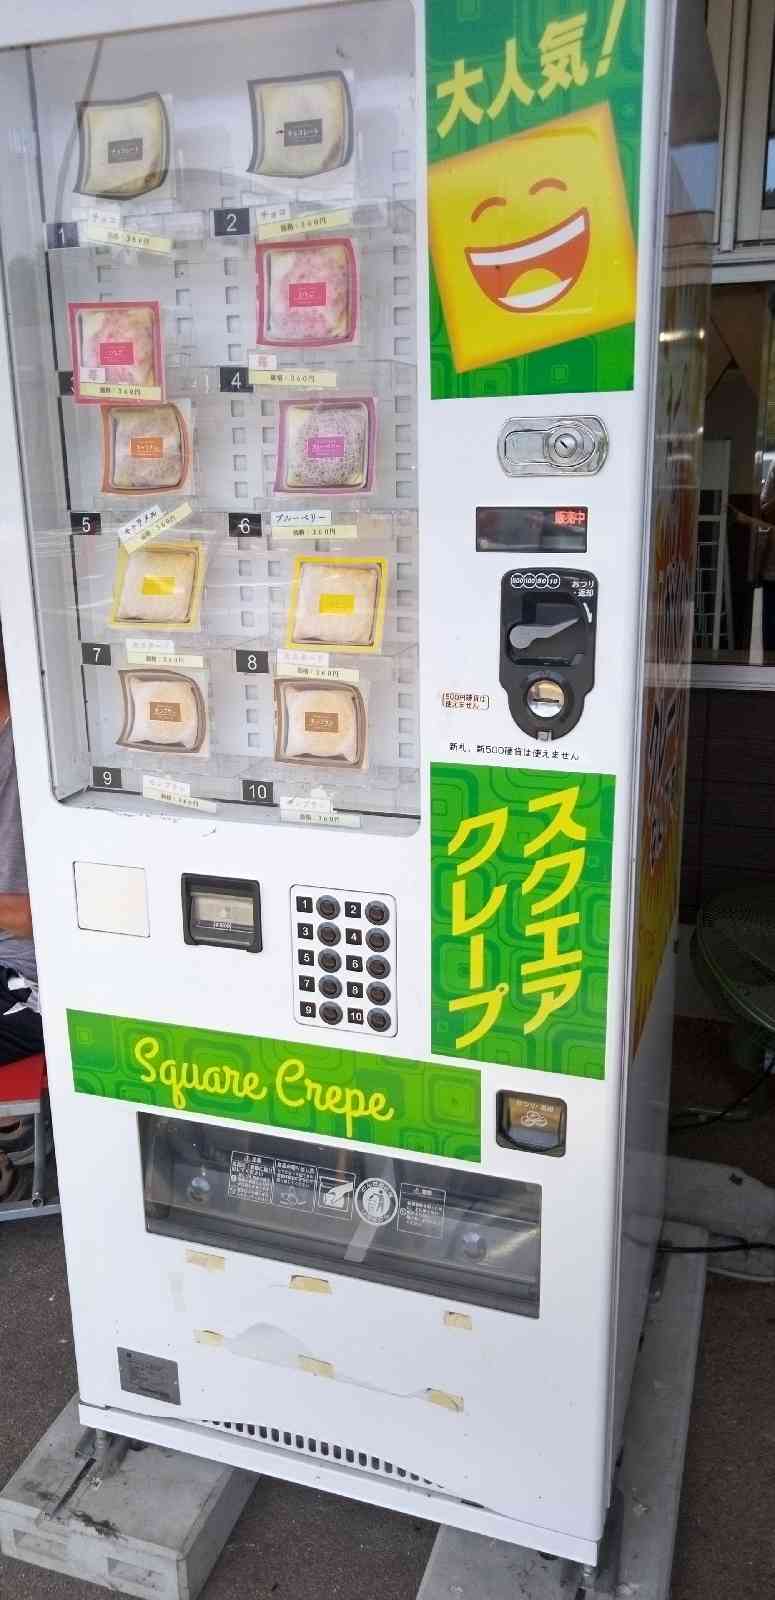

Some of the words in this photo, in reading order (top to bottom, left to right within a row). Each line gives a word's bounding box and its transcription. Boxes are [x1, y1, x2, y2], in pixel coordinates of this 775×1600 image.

[225, 213, 237, 232] 2
[58, 226, 65, 246] 1
[230, 371, 242, 389] 4
[82, 516, 91, 532] 5
[555, 511, 586, 525] 販売中
[240, 517, 250, 534] 6
[92, 647, 102, 661] 7
[247, 654, 257, 671] 8
[103, 771, 112, 785] 9
[249, 784, 267, 799] 10
[302, 899, 308, 909] 1
[350, 904, 358, 914] 2
[521, 785, 587, 1035] スクエア
[302, 926, 309, 936] 3
[447, 807, 509, 1049] クレープ
[350, 933, 358, 941] 4
[303, 952, 310, 962] 5
[352, 959, 359, 969] 6
[304, 979, 310, 988] 7
[352, 985, 359, 995] 8
[305, 1005, 312, 1014] 9
[350, 1011, 362, 1021] 10
[134, 1036, 268, 1109] Square
[276, 1058, 396, 1138] Crepe
